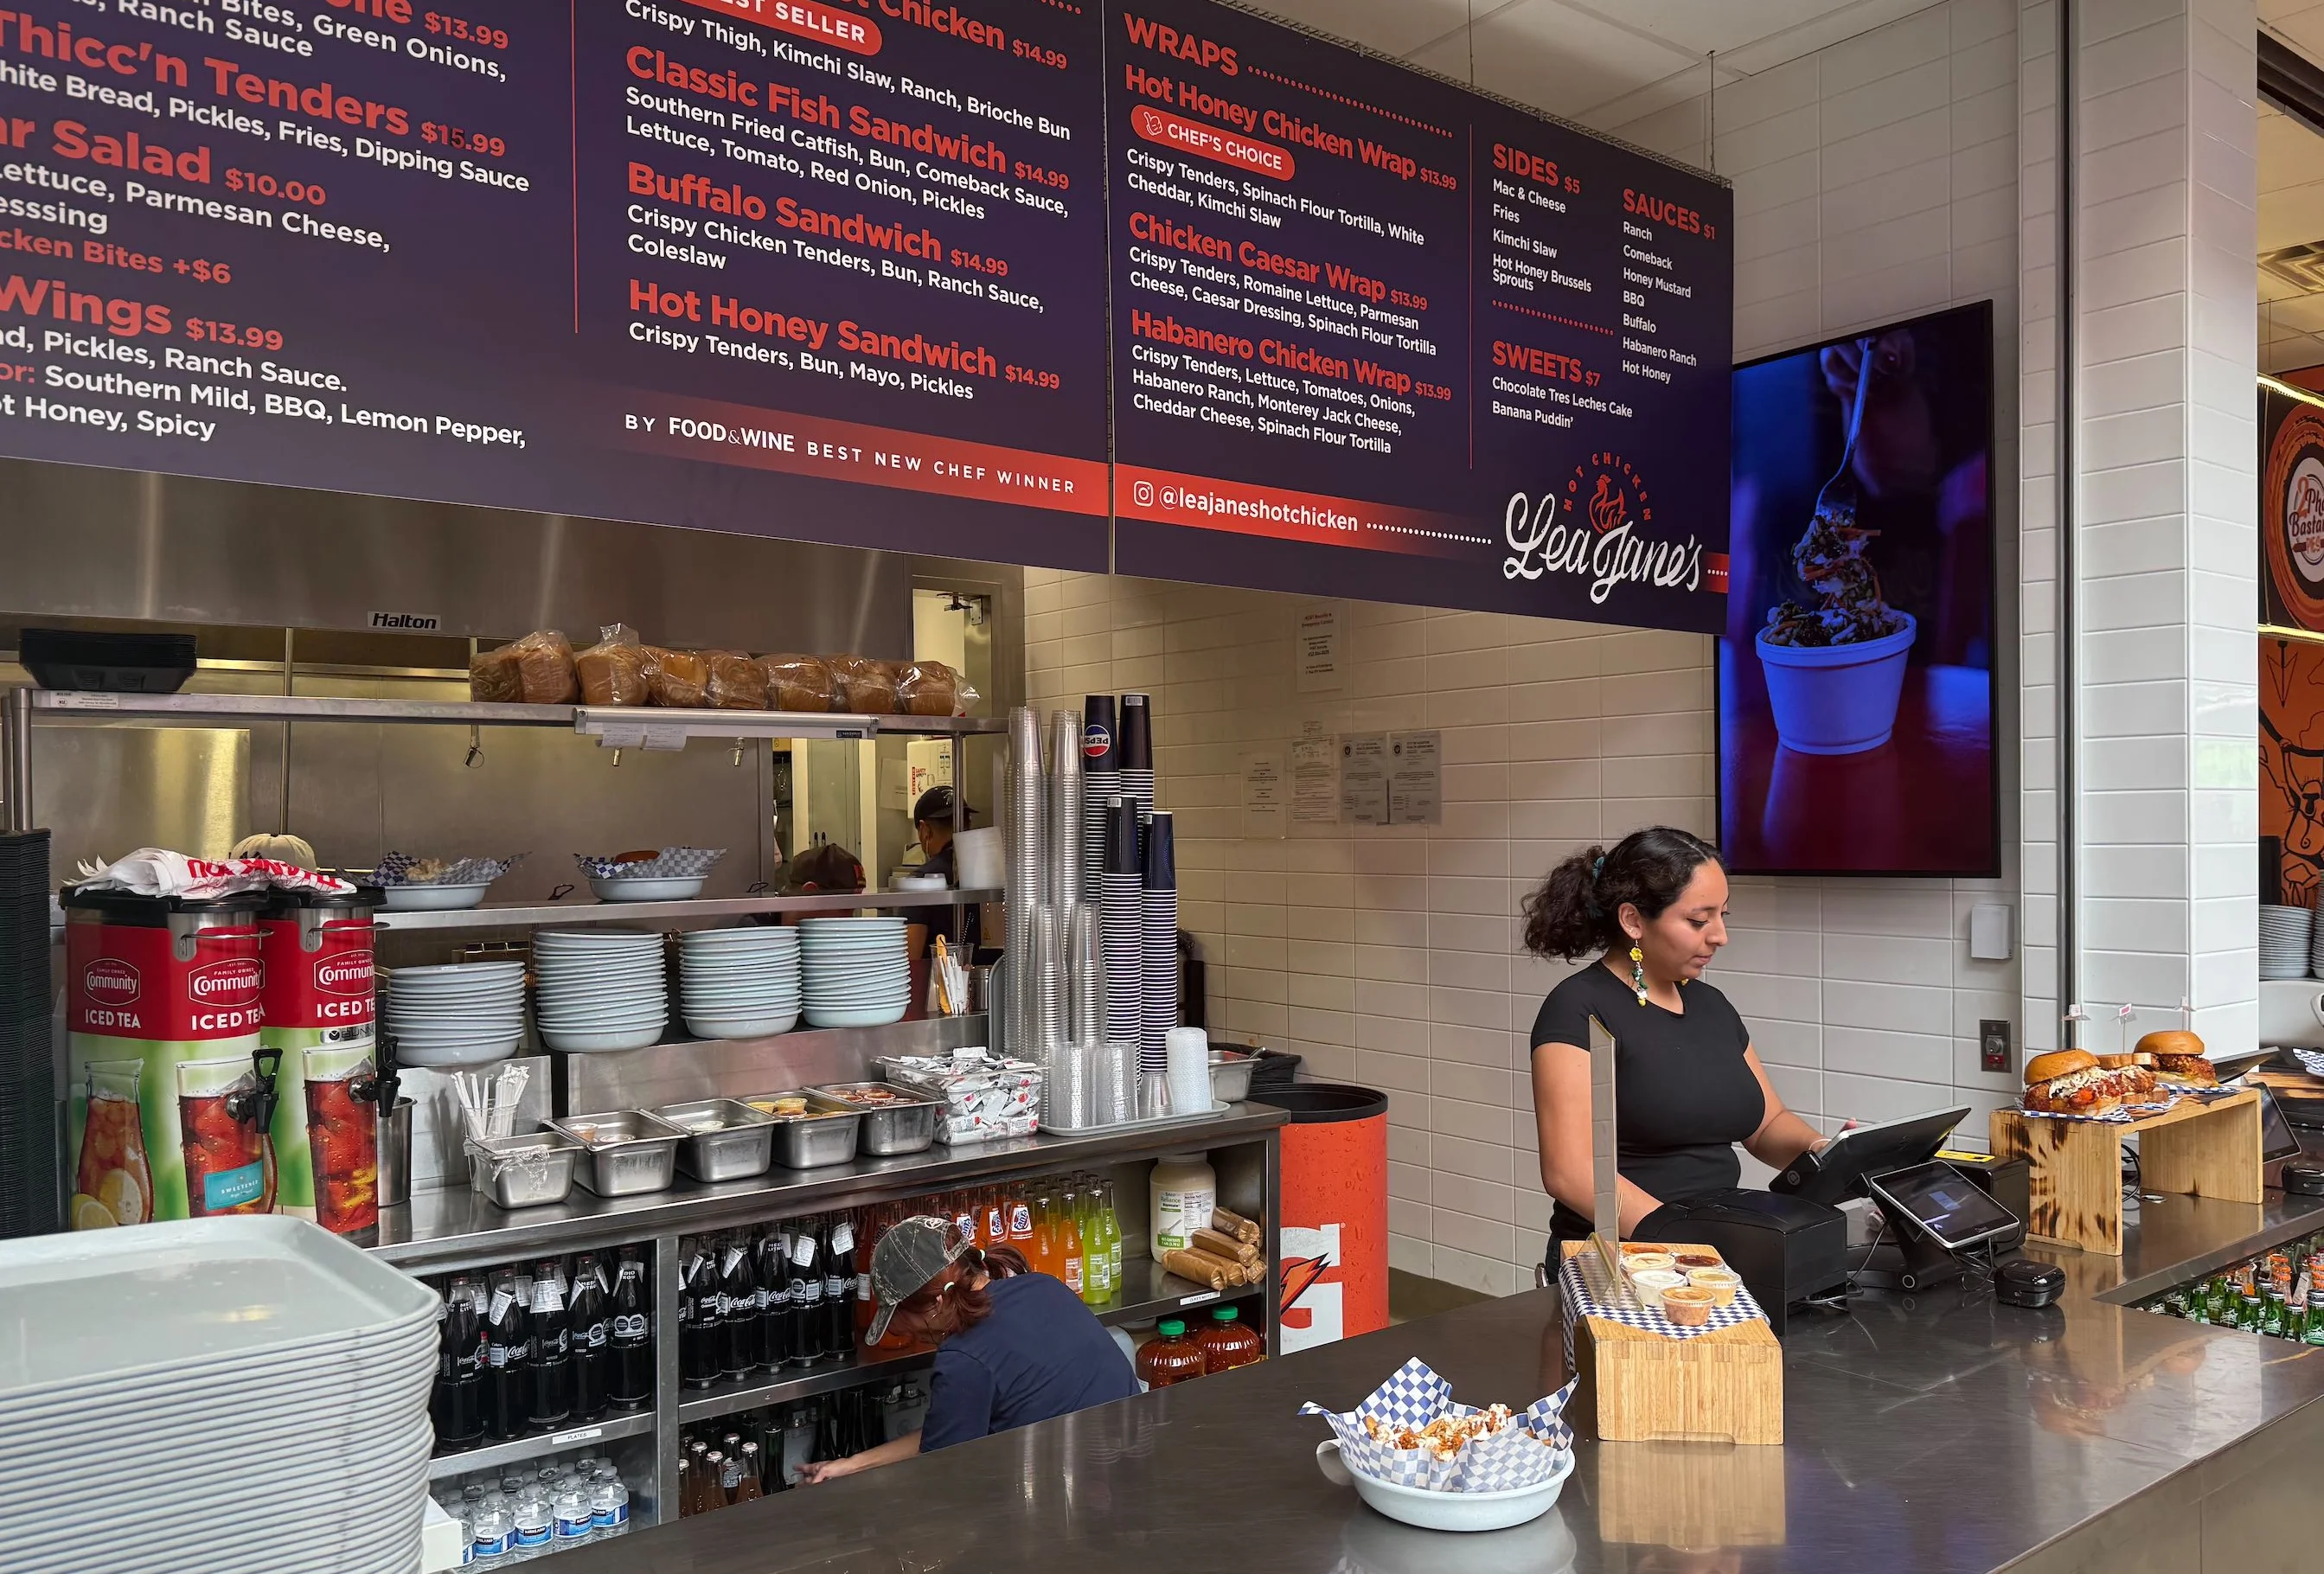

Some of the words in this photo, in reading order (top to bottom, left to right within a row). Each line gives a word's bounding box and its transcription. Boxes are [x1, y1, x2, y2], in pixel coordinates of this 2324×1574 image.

[425, 11, 509, 50] $13.99
[775, 1, 865, 44] SELLER
[878, 0, 1005, 51] Chicken
[1013, 39, 1067, 70] $14.99
[1124, 13, 1239, 77] WRAPS
[0, 10, 188, 87] Thicc'n
[203, 57, 409, 136] Tenders
[421, 121, 506, 157] $15.99
[625, 0, 695, 35] Crispy
[701, 18, 767, 57] Thigh,
[773, 39, 841, 75] Kimchi
[847, 61, 895, 94] Slaw,
[900, 76, 962, 112] Ranch,
[967, 96, 1034, 130] Brioche
[1038, 116, 1071, 141] Bun
[626, 45, 759, 107] Classic
[768, 82, 840, 130] Fish
[848, 105, 1007, 174] Sandwich
[1015, 161, 1070, 190] $14.99
[1125, 64, 1174, 104] Hot
[1179, 81, 1258, 133] Honey
[1263, 109, 1354, 159] Chicken
[1358, 138, 1417, 181] Wrap
[1420, 168, 1457, 191] $13.99
[54, 119, 211, 184] Salad
[225, 168, 326, 207] $10.00
[1167, 123, 1222, 152] CHEF'S
[1226, 140, 1283, 171] CHOICE
[1493, 143, 1559, 187] SIDES
[1565, 176, 1580, 195] $5
[628, 161, 767, 221] Buffalo
[776, 196, 942, 262] Sandwich
[951, 248, 1008, 277] $14.99
[1127, 148, 1175, 177] Crispy
[1178, 162, 1239, 196] Tenders,
[1242, 181, 1296, 211] Spinach
[1300, 197, 1335, 221] Flour
[1337, 208, 1385, 238] Tortilla,
[1387, 222, 1424, 246] White
[1127, 172, 1194, 208] Cheddar,
[1197, 191, 1246, 219] Kimchi
[1249, 206, 1282, 228] Slaw
[1493, 178, 1515, 197] Mac
[1517, 186, 1526, 201] &
[1527, 189, 1566, 214] Cheese
[1493, 202, 1520, 223] Fries
[1623, 188, 1700, 234] SAUCES
[1704, 225, 1715, 239] $1
[628, 234, 727, 270] Coleslaw
[1493, 227, 1530, 252] Kimchi
[1532, 240, 1558, 259] Slaw
[1623, 221, 1653, 241] Ranch
[1129, 211, 1232, 262] Chicken
[1239, 240, 1321, 284] Caesar
[1325, 262, 1386, 304] Wrap
[1391, 289, 1428, 311] $13.99
[1492, 267, 1534, 291] Sprouts
[1493, 253, 1513, 272] Hot
[1514, 259, 1549, 283] Honey
[1551, 269, 1592, 293] Brussels
[1623, 244, 1673, 271] Comeback
[1623, 266, 1654, 289] Honey
[1655, 276, 1692, 298] Mustard
[1623, 290, 1645, 307] BBQ
[0, 275, 173, 338] Wings
[186, 318, 284, 352] $13.99
[1130, 271, 1188, 302] Cheese,
[1192, 285, 1240, 310] Caesar
[1244, 298, 1305, 329] Dressing,
[1308, 313, 1359, 339] Spinach
[1361, 325, 1394, 346] Flour
[1395, 333, 1437, 356] Tortilla
[1623, 312, 1656, 334] Buffalo
[1131, 309, 1254, 360] Habanero
[1258, 338, 1349, 381] Chicken
[1353, 358, 1412, 396] Wrap
[1415, 381, 1451, 401] $13.99
[1493, 340, 1583, 383] SWEETS
[1585, 370, 1601, 387] $7
[1623, 336, 1668, 359] Habanero
[1669, 349, 1697, 367] Ranch
[1623, 359, 1640, 375] Hot
[1642, 363, 1671, 385] Honey
[25, 395, 128, 432] Honey,
[136, 409, 216, 443] Spicy
[44, 364, 182, 403] Southern
[190, 383, 256, 416] Mild,
[265, 393, 333, 425] BBQ,
[341, 402, 428, 434] Lemon
[435, 415, 526, 450] Pepper,
[1132, 368, 1205, 397] Habanero
[1207, 383, 1254, 409] Ranch,
[1258, 393, 1320, 421] Monterey
[1322, 406, 1352, 425] Jack
[1354, 412, 1402, 437] Cheese,
[1492, 375, 1546, 400] Chocolate
[1548, 387, 1571, 405] Tres
[1572, 393, 1607, 413] Leches
[1609, 401, 1633, 418] Cake
[1492, 400, 1533, 421] Banana
[1534, 408, 1574, 429] Puddin'
[625, 413, 656, 432] BY
[807, 440, 862, 463] BEST
[874, 451, 922, 471] NEW
[933, 460, 986, 480] CHEF
[996, 470, 1074, 494] WINNER
[1159, 485, 1358, 532] @leajaneshotchicken
[1563, 465, 1584, 512] HOT
[1591, 451, 1651, 521] CHICKEN
[1502, 491, 1591, 580] Lea
[1589, 520, 1702, 605] Jane's
[372, 612, 437, 630] Halton
[1085, 737, 1109, 746] PEPS
[86, 970, 138, 995] Community
[85, 1008, 115, 1026] ICED
[117, 1012, 142, 1029] TEA
[191, 1011, 243, 1031] ICED
[317, 1000, 362, 1018] ICED
[364, 996, 375, 1013] TE
